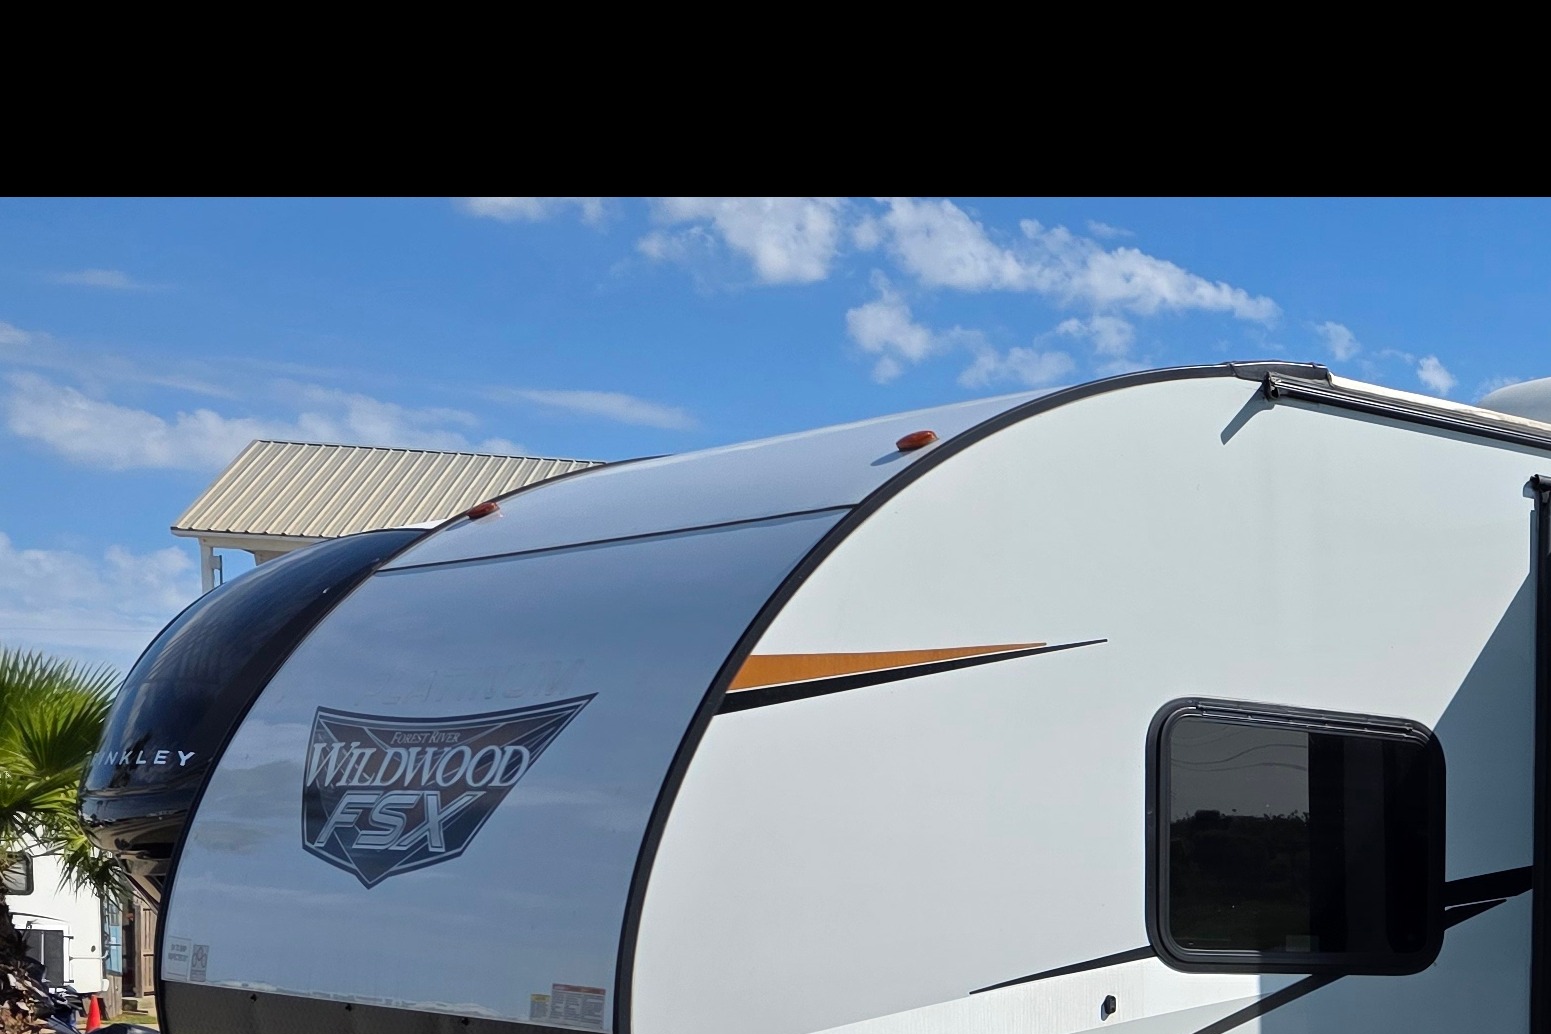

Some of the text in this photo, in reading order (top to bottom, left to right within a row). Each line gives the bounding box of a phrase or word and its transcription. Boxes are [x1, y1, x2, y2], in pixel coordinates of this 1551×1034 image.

[390, 730, 461, 744] FOREST RIVER
[306, 741, 530, 787] WILDWOOD
[314, 790, 486, 852] FSX
